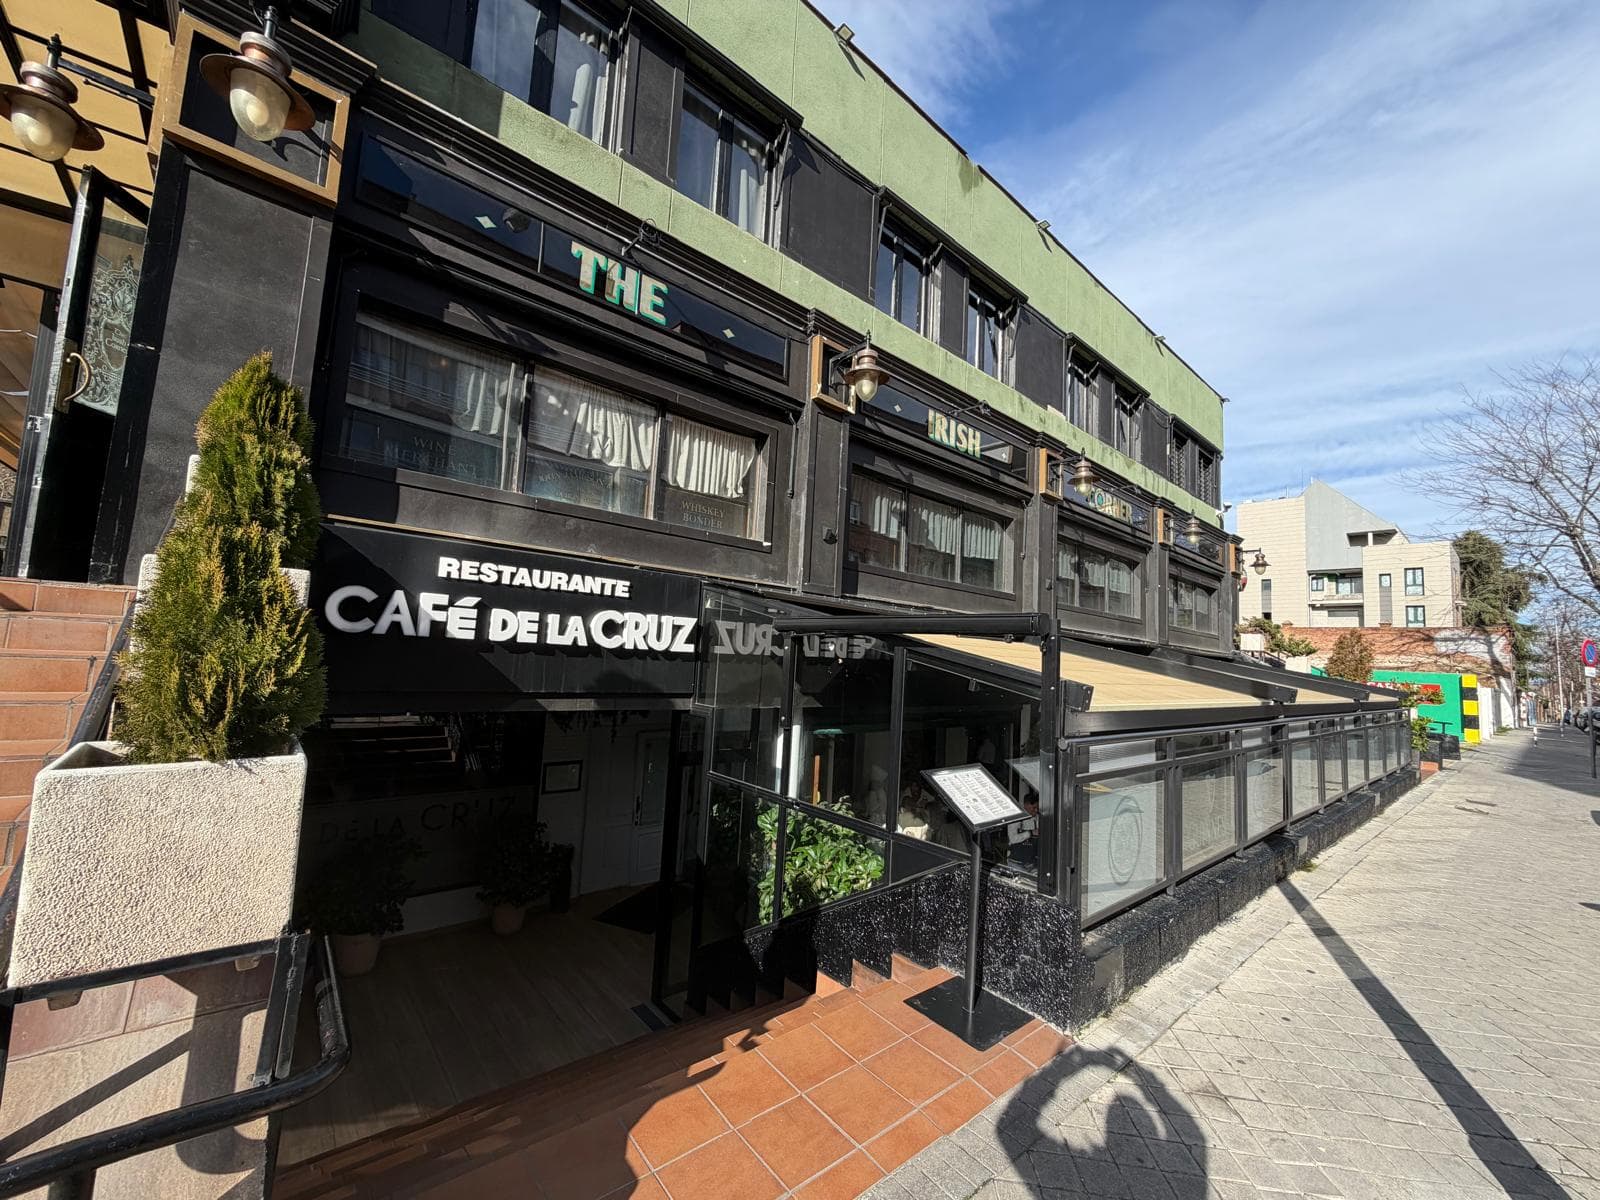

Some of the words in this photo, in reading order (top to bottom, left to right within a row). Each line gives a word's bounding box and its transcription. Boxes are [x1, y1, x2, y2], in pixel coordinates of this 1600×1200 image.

[570, 240, 669, 326] THE
[414, 436, 458, 457] WINE
[928, 408, 982, 459] IRISH
[681, 500, 725, 518] WHISKEY
[683, 512, 723, 529] BONDER
[437, 556, 631, 599] RESTAURANTE
[324, 585, 482, 641] CAFÉ
[489, 608, 540, 645] DE
[546, 613, 588, 648] LA
[590, 609, 698, 654] CRUZ
